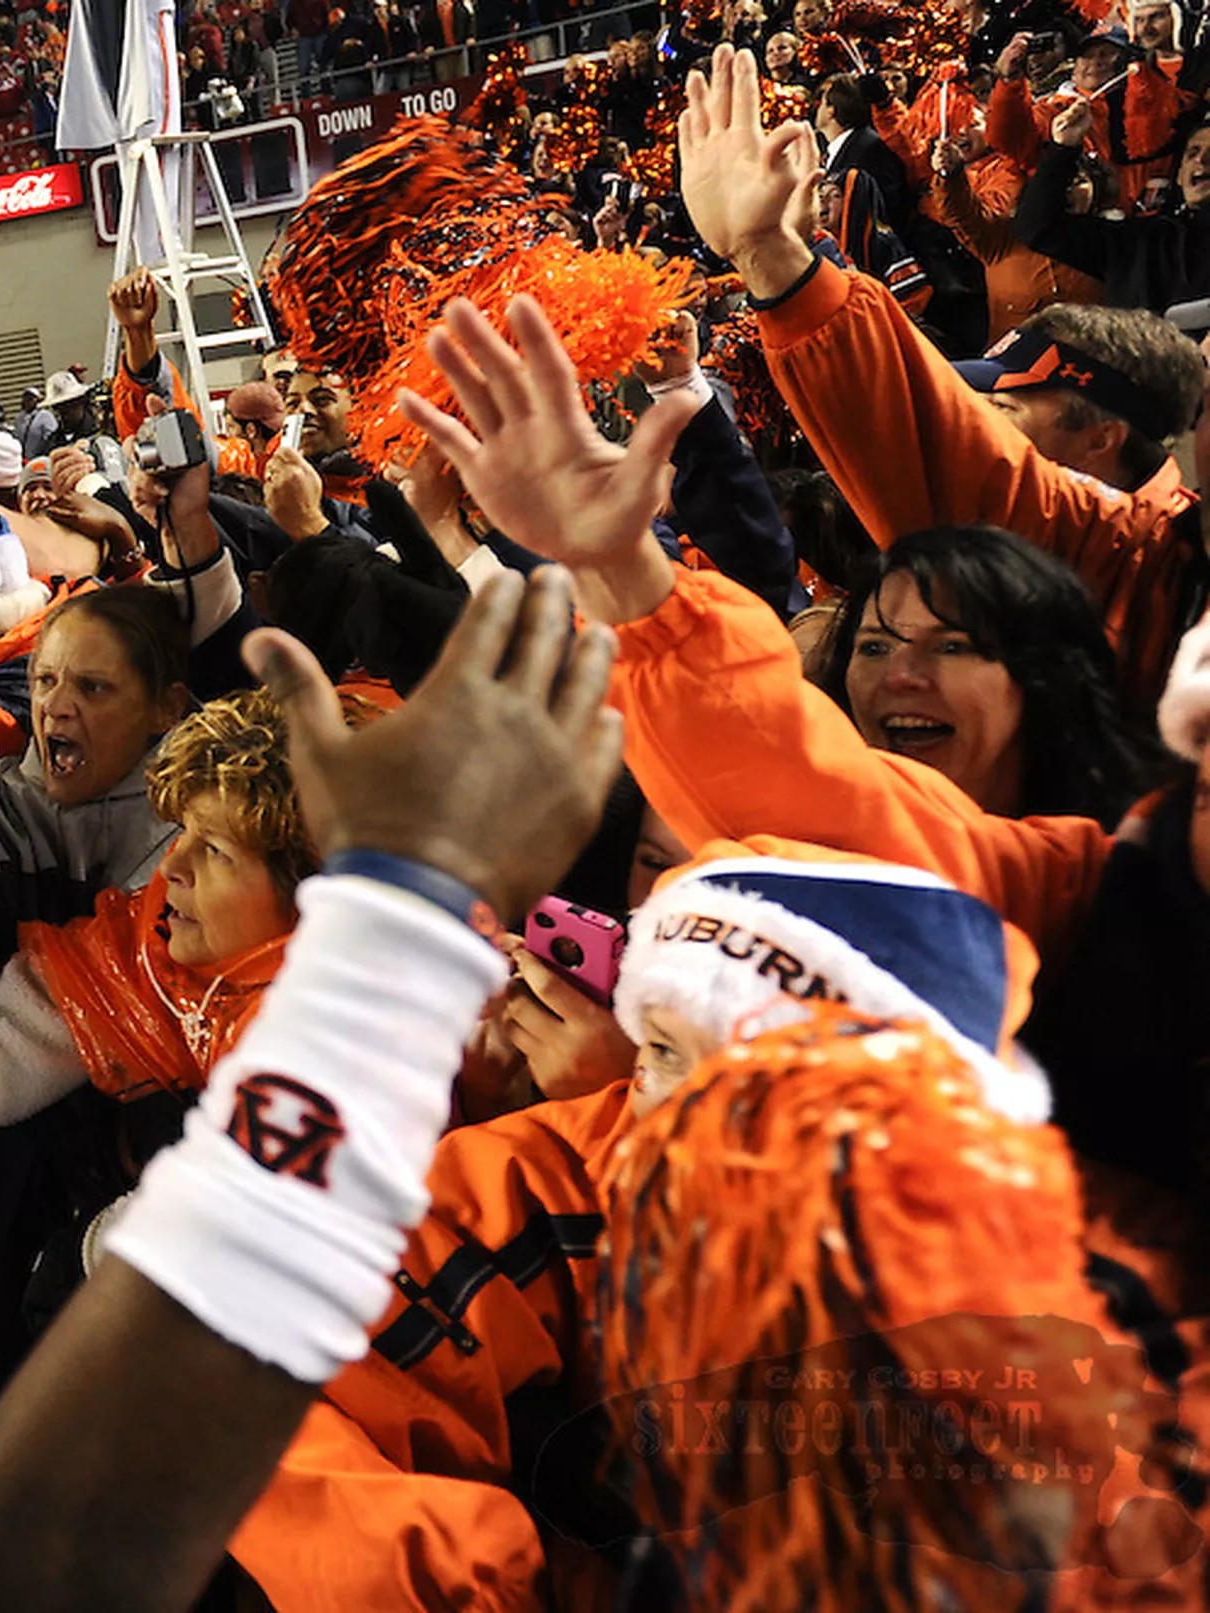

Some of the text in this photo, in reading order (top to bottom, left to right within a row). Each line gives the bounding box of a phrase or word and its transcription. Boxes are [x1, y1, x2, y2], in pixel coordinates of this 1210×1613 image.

[318, 87, 457, 138] DOWN TO GO
